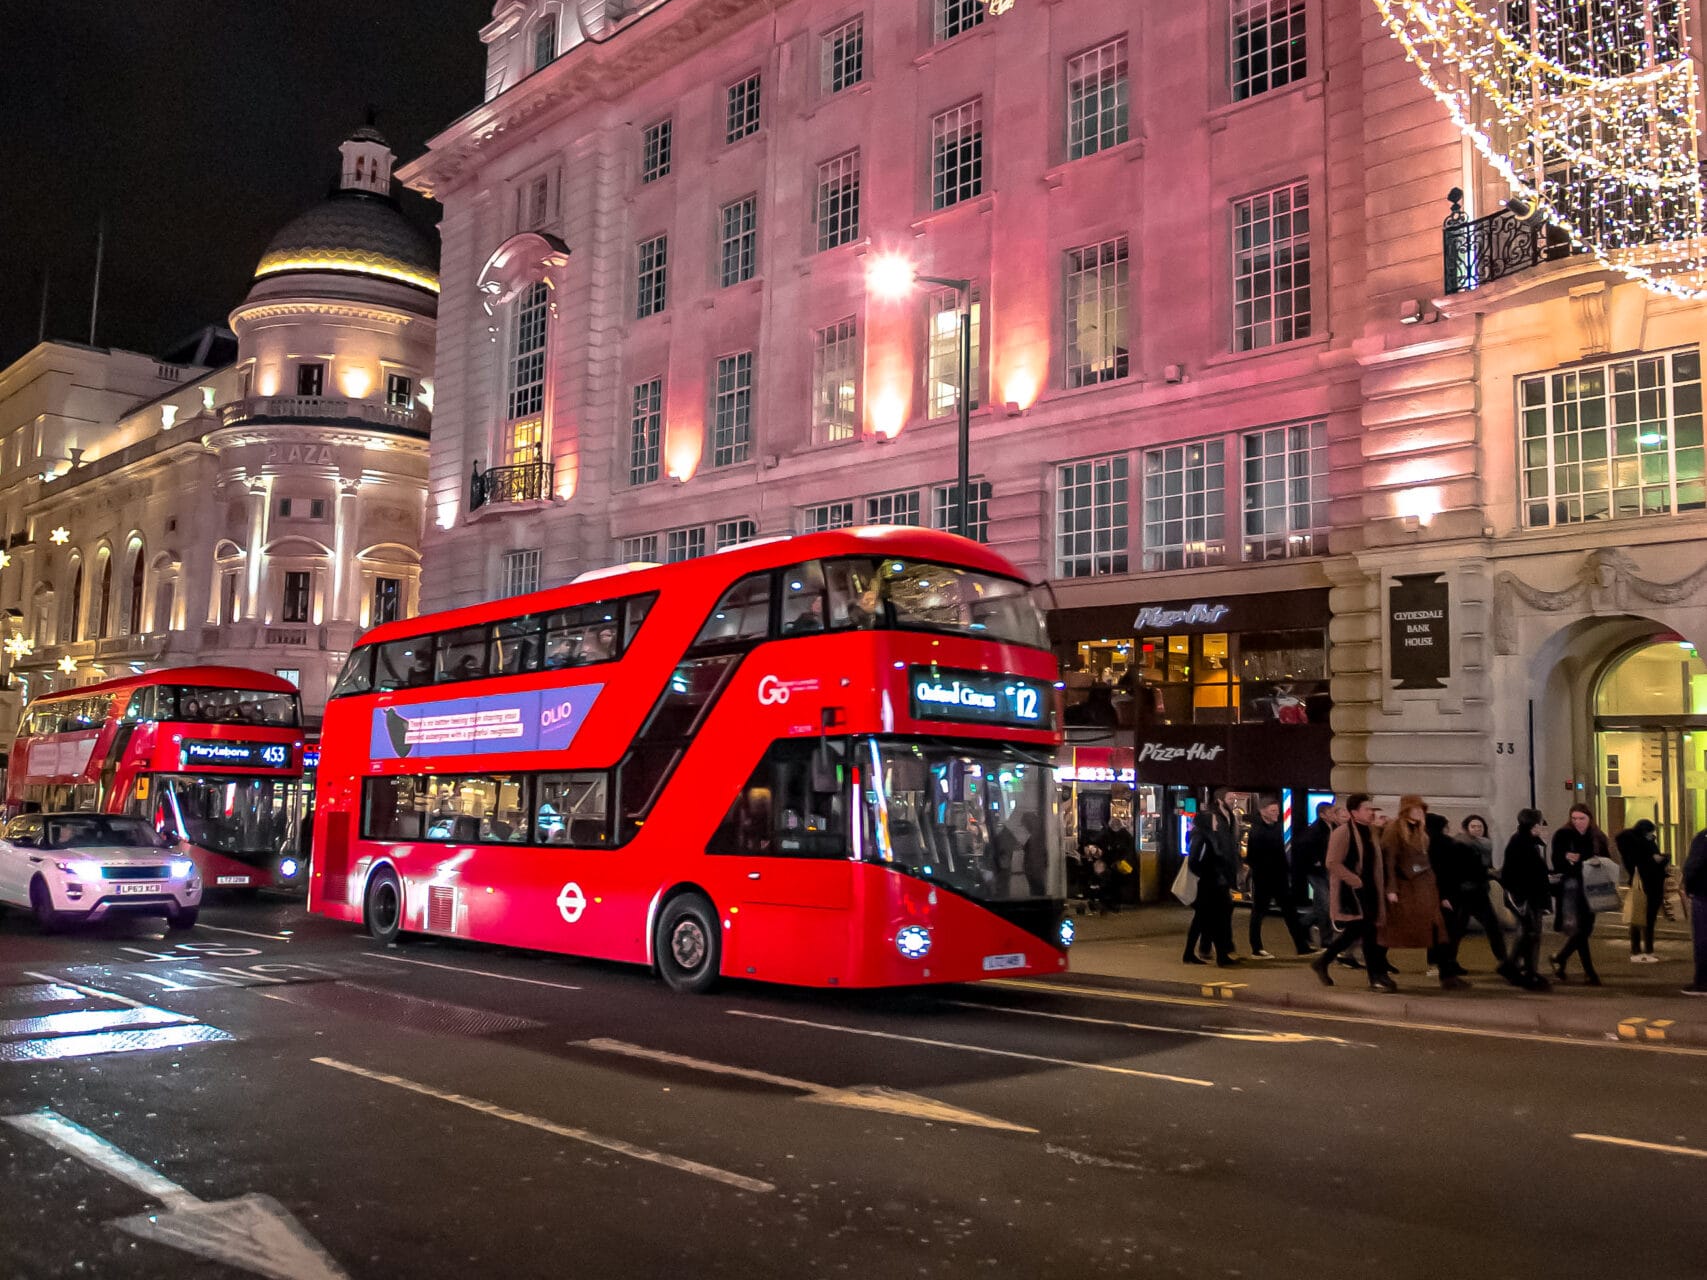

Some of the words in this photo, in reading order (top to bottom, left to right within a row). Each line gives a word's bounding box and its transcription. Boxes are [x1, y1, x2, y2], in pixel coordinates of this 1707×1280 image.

[1394, 610, 1443, 620] CLYDESDALE
[1407, 624, 1430, 632] BANK
[1405, 637, 1433, 646] HOUSE
[917, 681, 960, 704] Oxford
[1016, 688, 1038, 718] 12
[541, 701, 572, 727] OLIO
[190, 745, 250, 758] Marylebone
[263, 747, 285, 762] 453
[1138, 743, 1185, 762] Pizza
[1186, 743, 1224, 760] Hut
